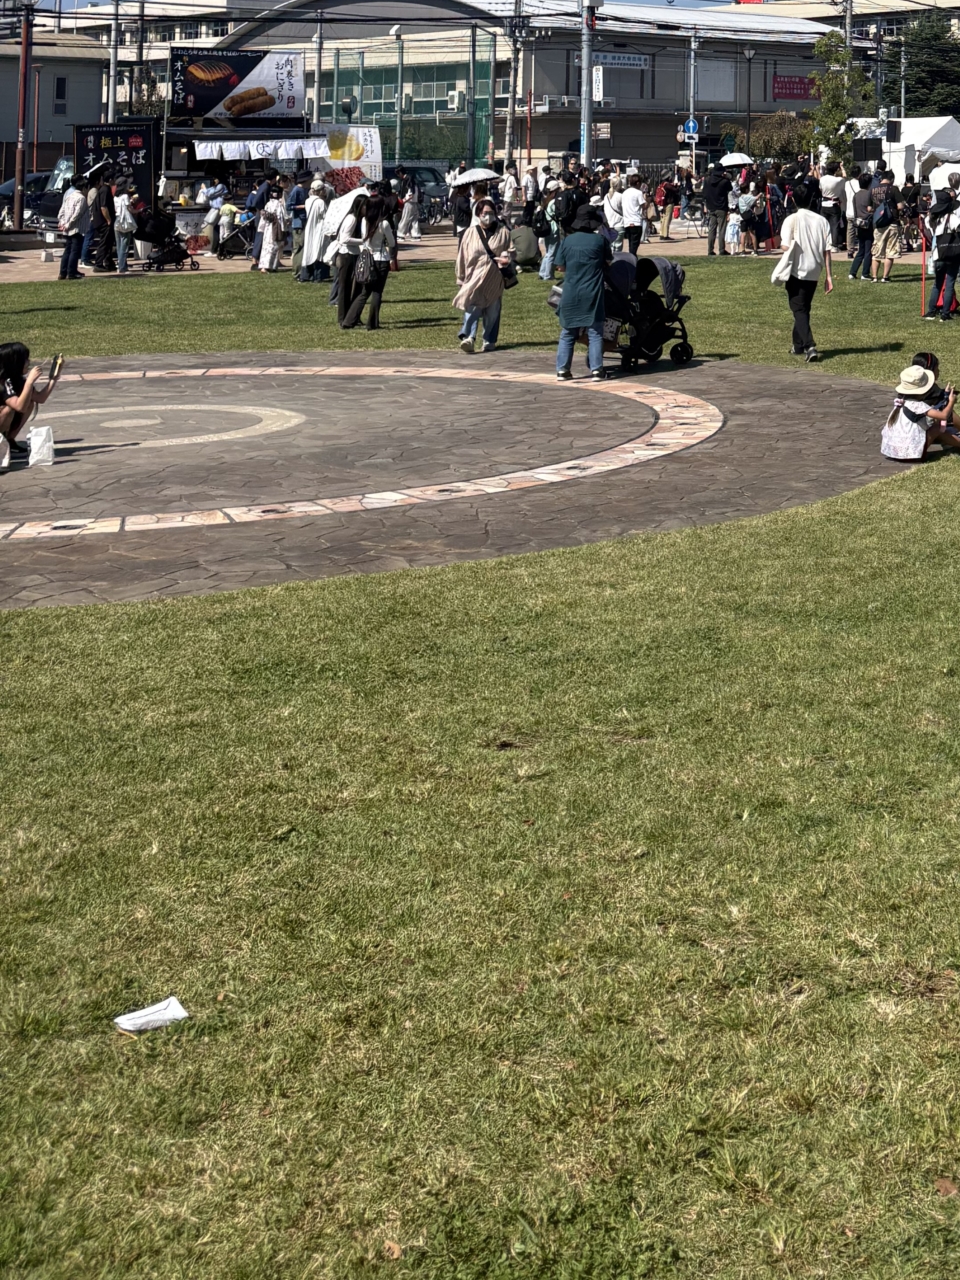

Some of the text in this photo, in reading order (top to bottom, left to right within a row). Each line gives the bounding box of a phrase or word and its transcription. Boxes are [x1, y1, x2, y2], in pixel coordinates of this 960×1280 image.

[173, 60, 184, 104] オムそば
[275, 61, 286, 104] おにぎり
[284, 57, 295, 91] 肉巻き
[83, 149, 146, 166] オムそば
[100, 136, 125, 149] 極上
